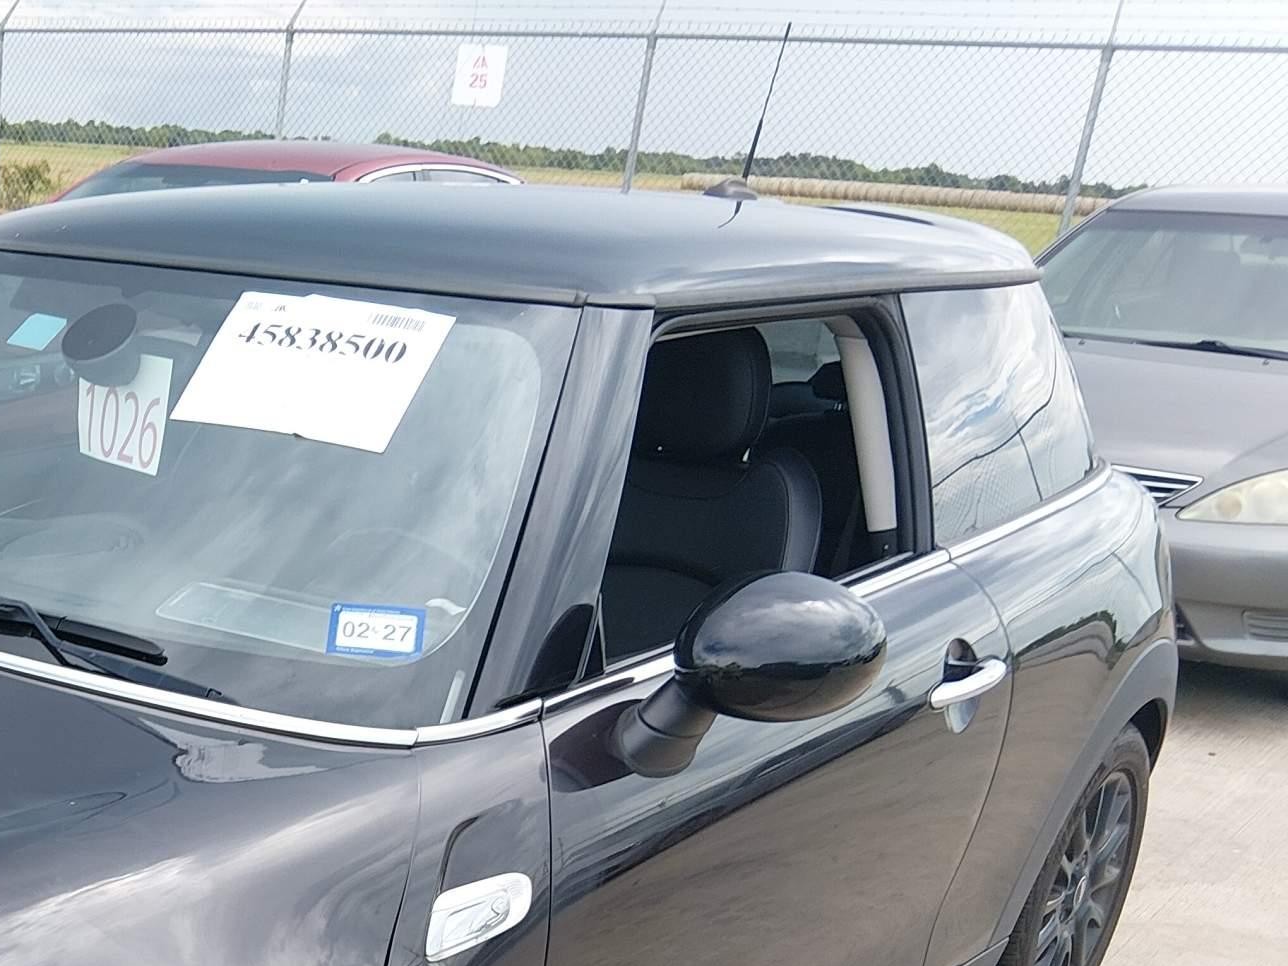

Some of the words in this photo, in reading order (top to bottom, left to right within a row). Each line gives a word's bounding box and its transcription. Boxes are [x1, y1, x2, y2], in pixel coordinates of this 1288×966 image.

[468, 73, 488, 89] 25
[238, 321, 408, 364] 45838500
[85, 382, 161, 469] 1026
[342, 620, 370, 639] 02
[382, 624, 413, 642] 27
